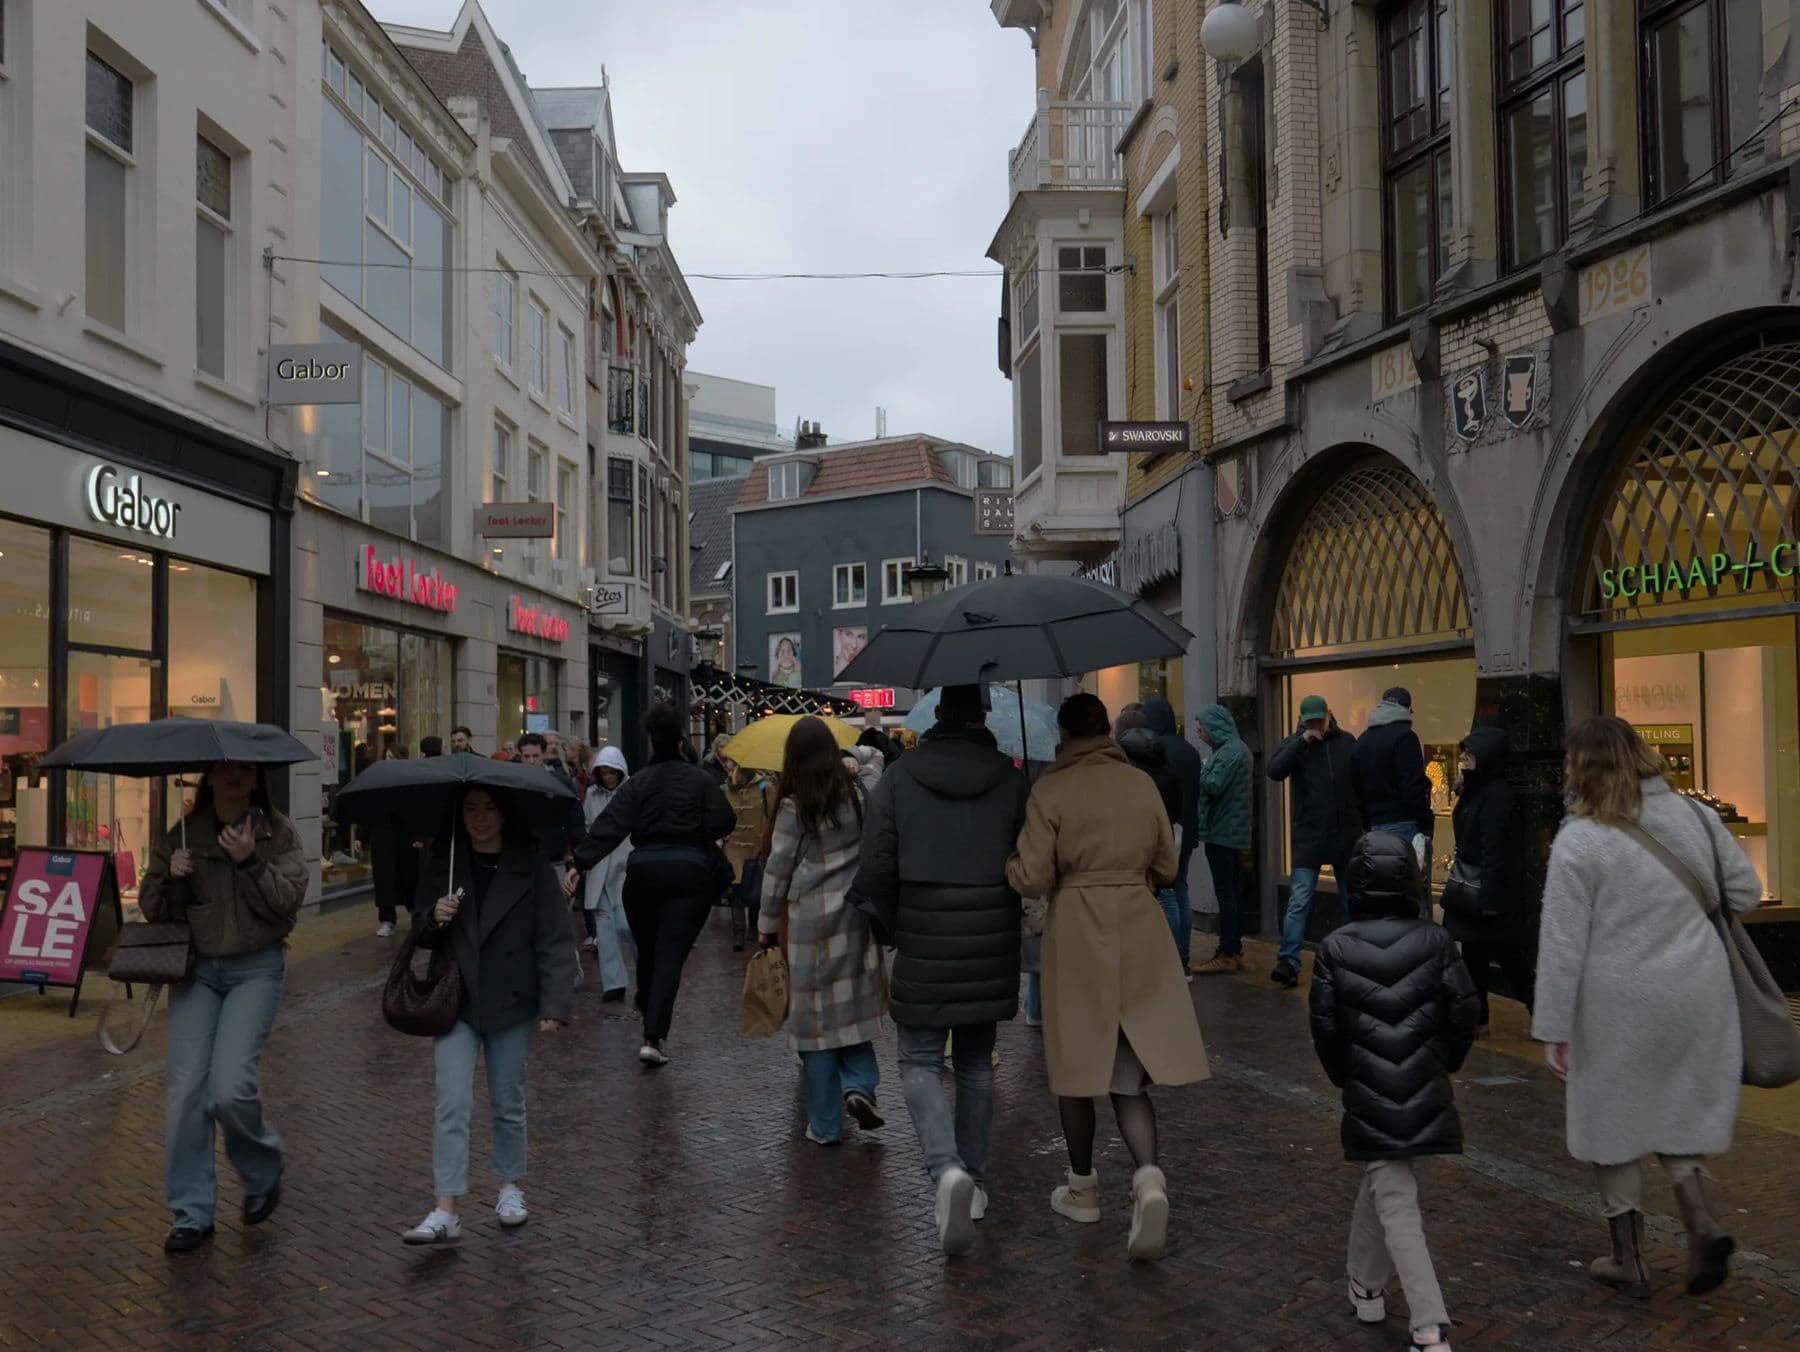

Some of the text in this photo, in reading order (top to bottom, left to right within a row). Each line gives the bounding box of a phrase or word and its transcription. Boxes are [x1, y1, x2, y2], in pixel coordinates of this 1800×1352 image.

[1585, 250, 1648, 312] 1906
[277, 358, 350, 380] Gabor
[1122, 430, 1182, 442] SWAROVSKI
[86, 463, 182, 538] Gabor
[360, 543, 460, 612] Foot Locker
[595, 586, 622, 608] Etos
[512, 594, 570, 642] Foot Locker
[191, 694, 217, 704] Gabor
